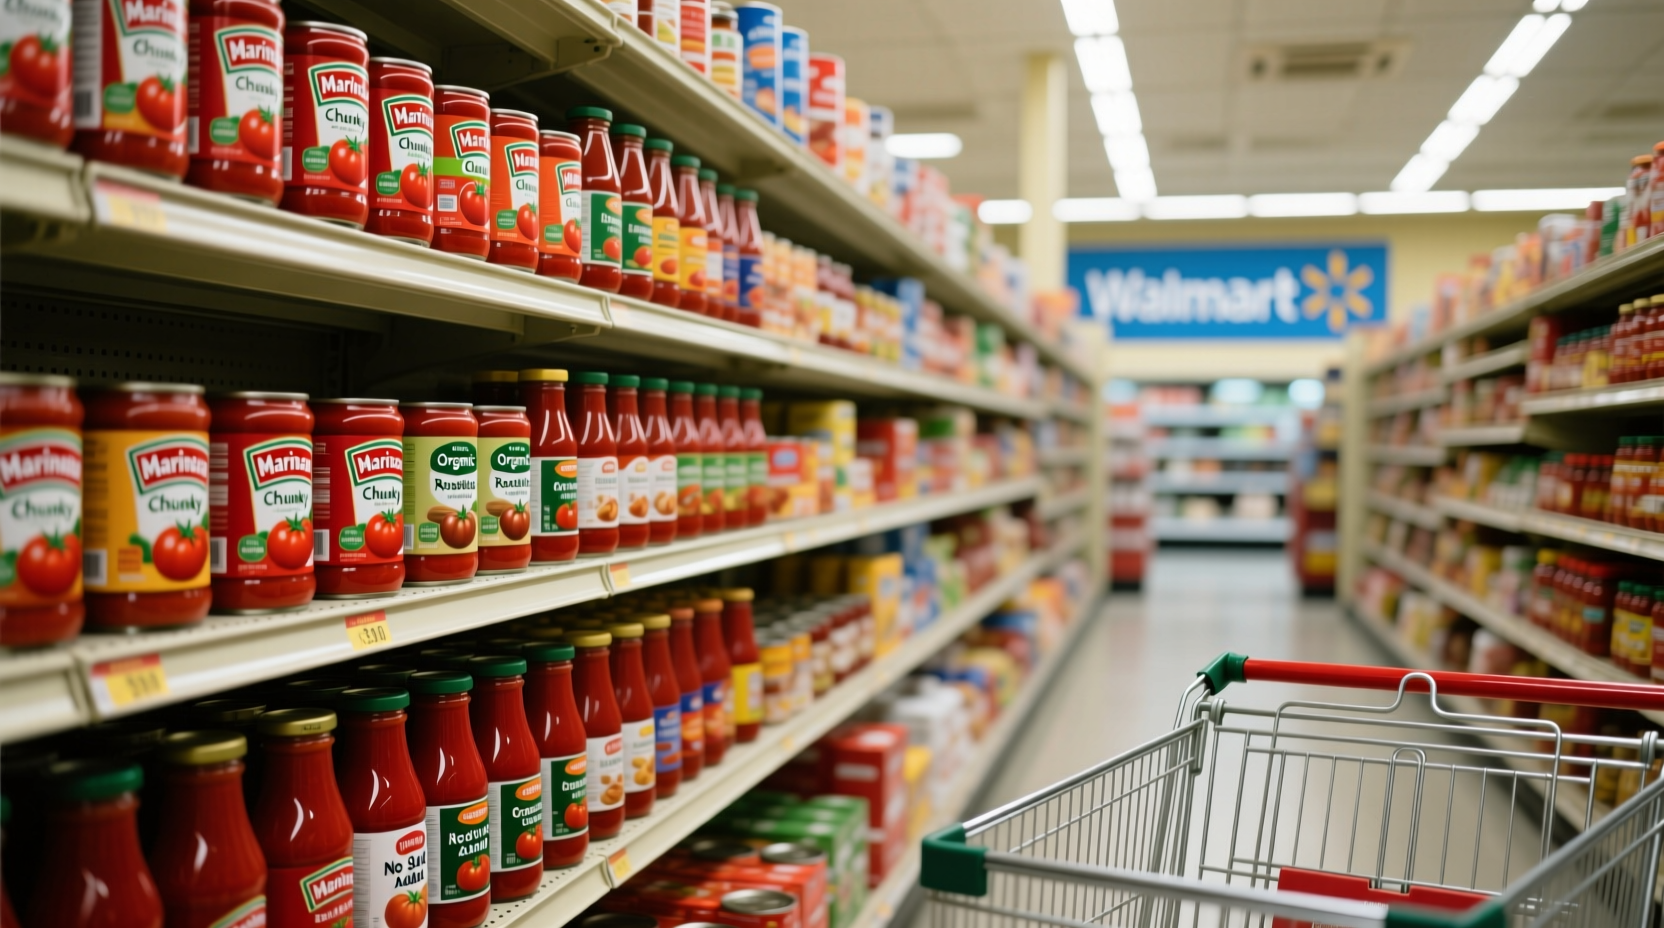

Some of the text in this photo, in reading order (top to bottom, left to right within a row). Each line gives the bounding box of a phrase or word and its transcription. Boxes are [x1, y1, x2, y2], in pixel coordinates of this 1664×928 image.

[1085, 267, 1300, 324] Walmart
[148, 493, 202, 516] Chunky
[263, 489, 309, 509] Chunky
[362, 485, 400, 506] Chunky
[384, 861, 403, 876] No
